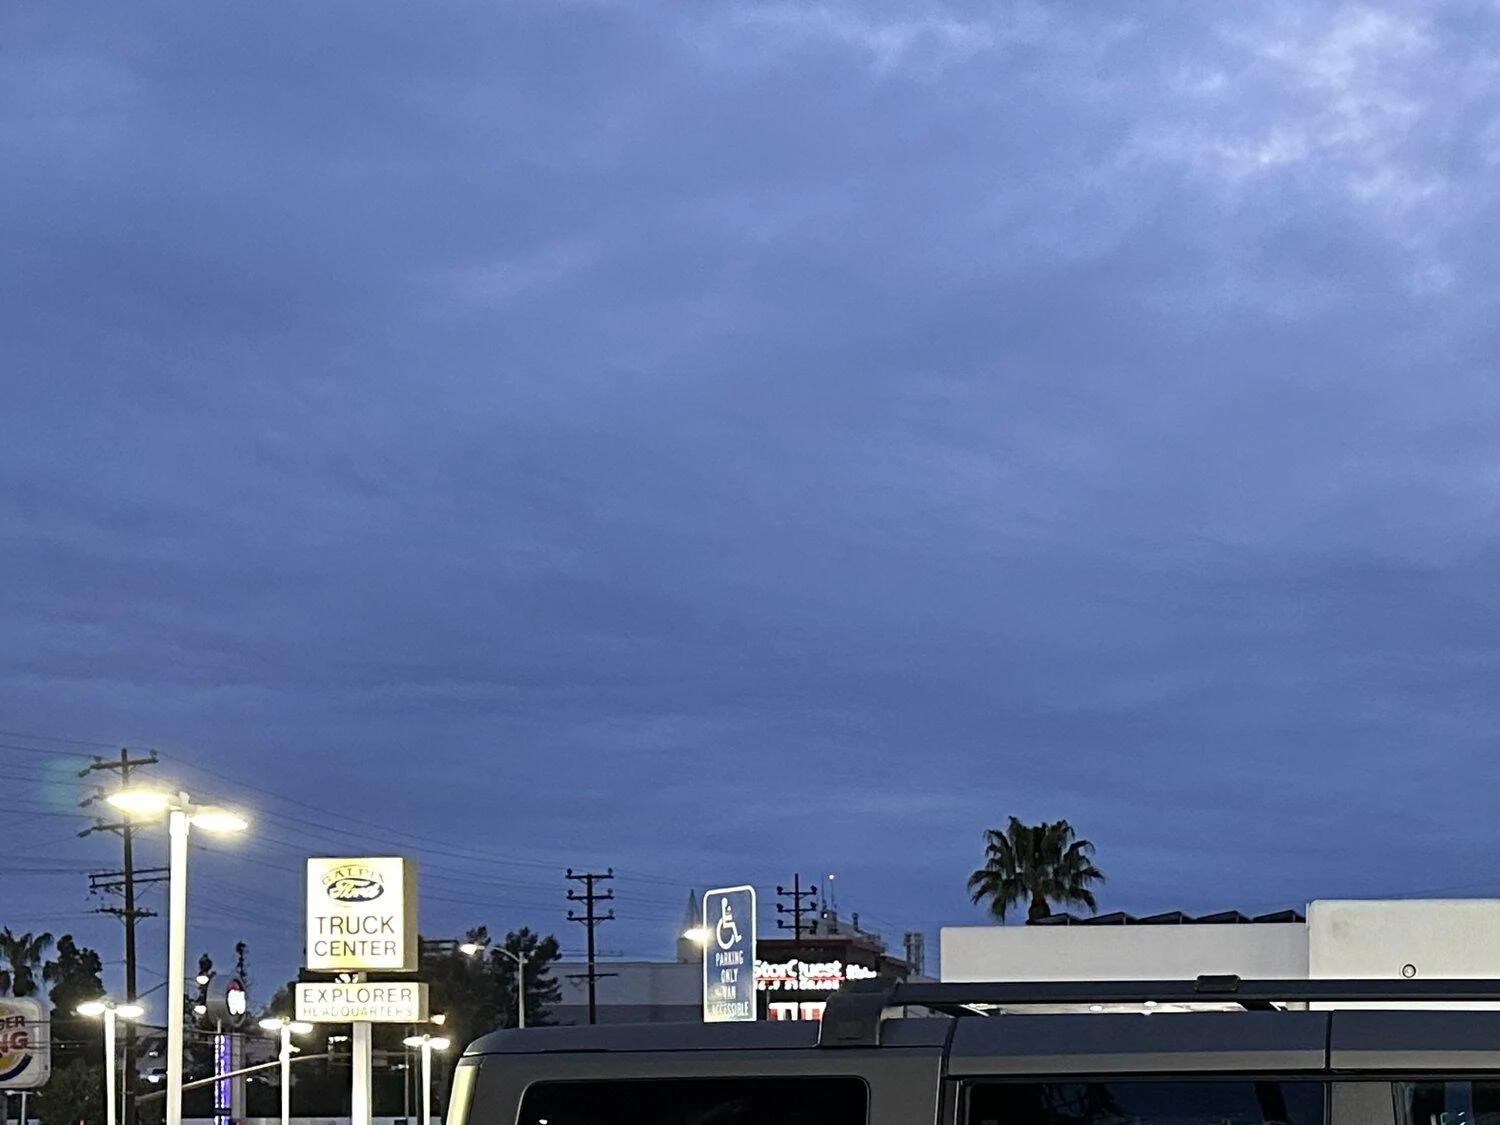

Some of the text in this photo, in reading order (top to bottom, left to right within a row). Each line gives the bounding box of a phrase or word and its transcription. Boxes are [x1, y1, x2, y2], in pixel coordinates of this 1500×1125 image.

[315, 916, 395, 935] TRUCK
[314, 940, 396, 957] CENTER
[715, 950, 744, 967] PARKING
[720, 968, 739, 984] ONLY
[303, 988, 412, 1003] EXPLORER
[303, 1006, 412, 1018] HEADQUARTERS
